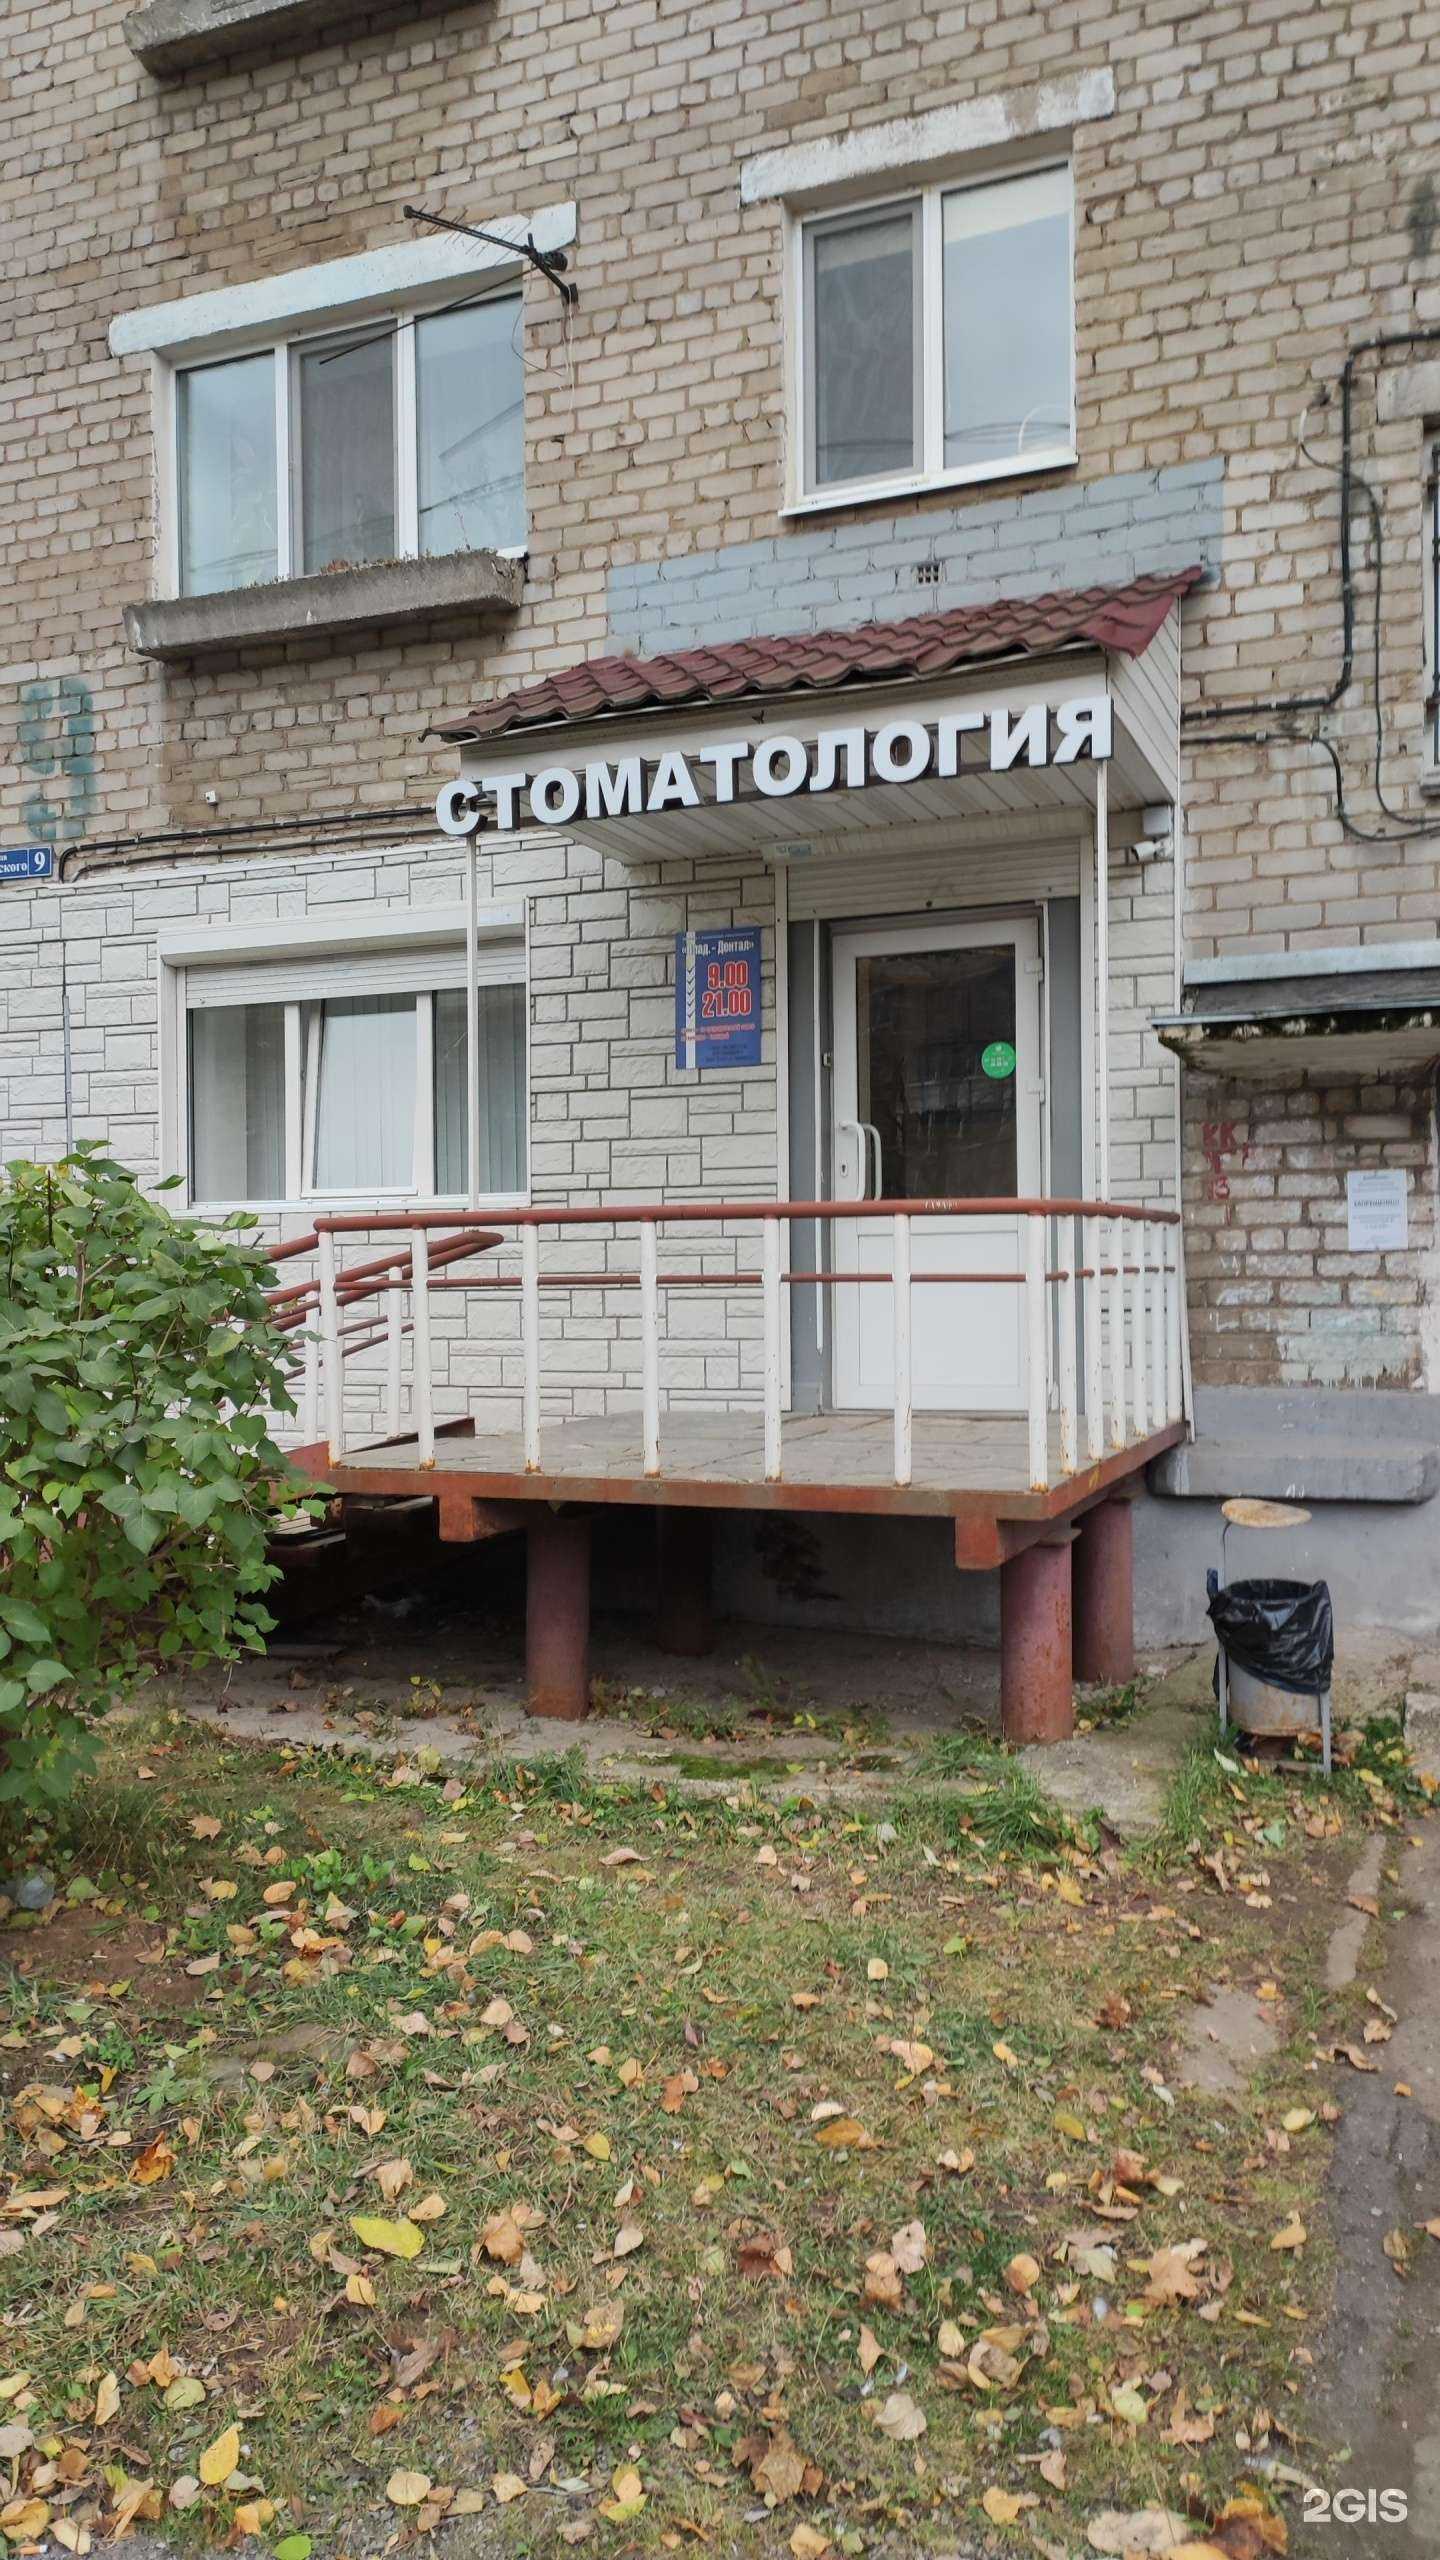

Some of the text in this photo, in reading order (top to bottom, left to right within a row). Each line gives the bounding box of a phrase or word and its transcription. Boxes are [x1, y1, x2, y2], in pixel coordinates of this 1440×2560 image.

[436, 694, 1112, 835] СТОМАТОЛОГИЯ
[34, 851, 46, 872] 9
[708, 960, 748, 990] 9.00
[702, 988, 752, 1018] 21.00
